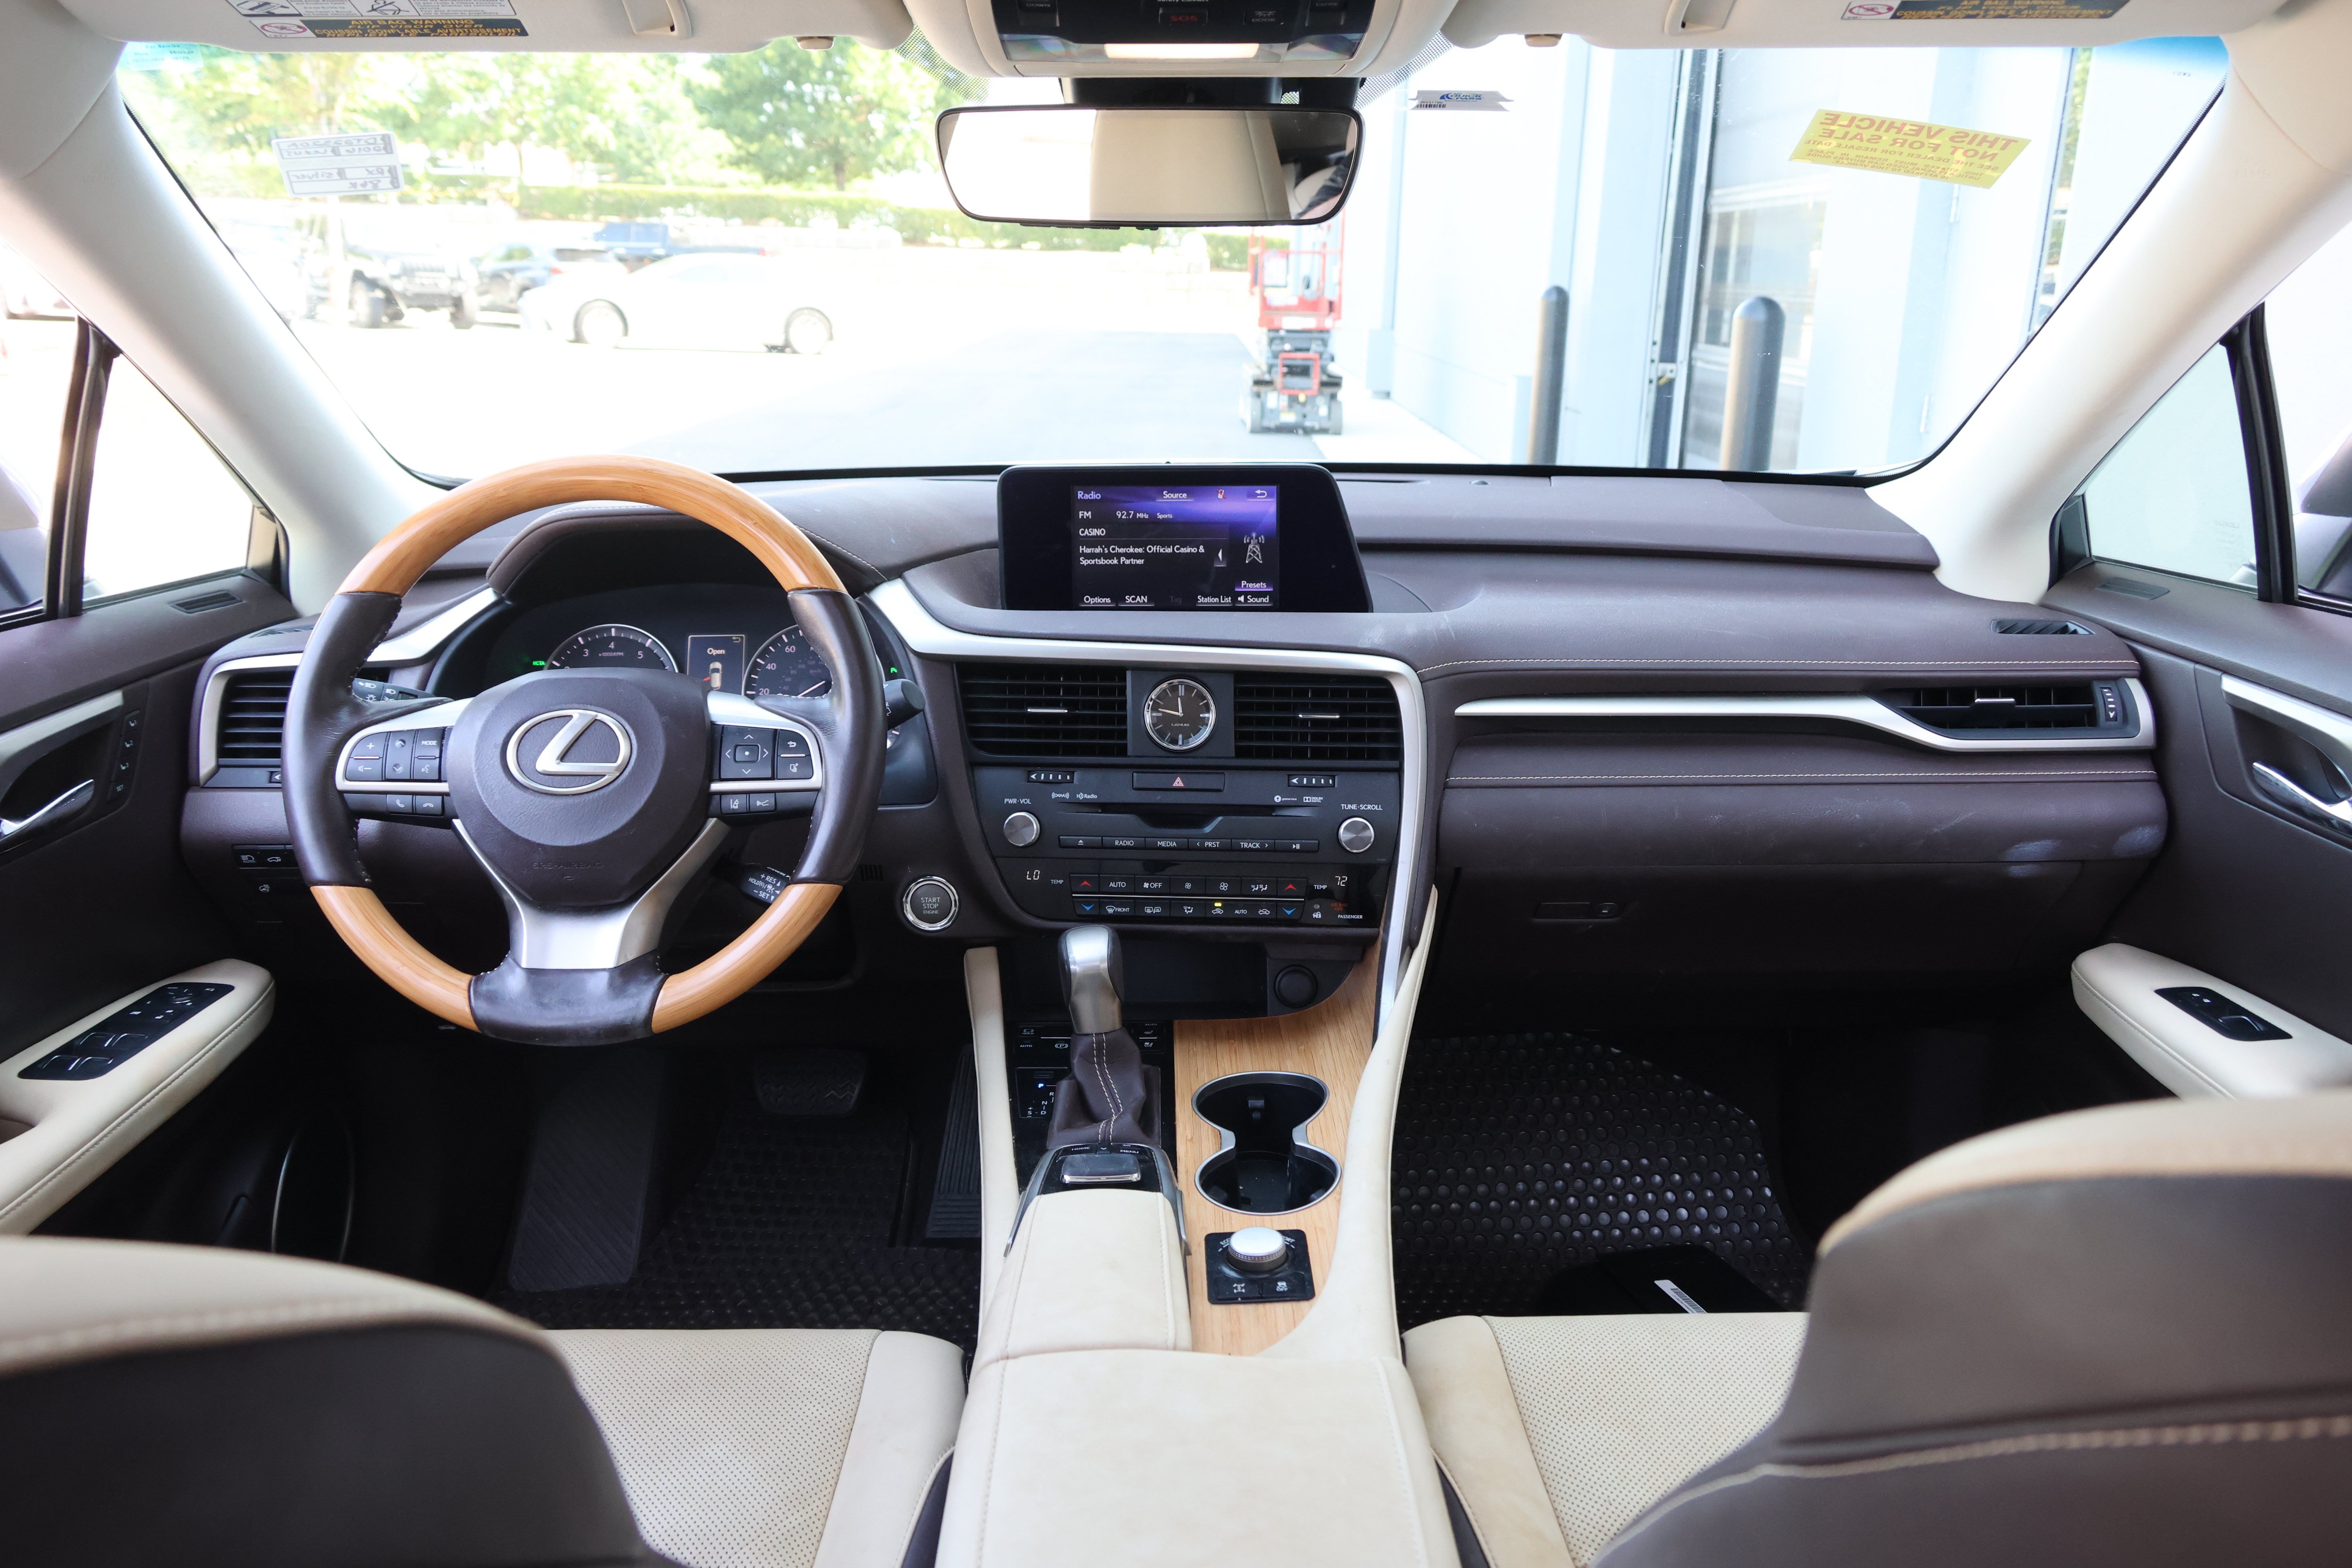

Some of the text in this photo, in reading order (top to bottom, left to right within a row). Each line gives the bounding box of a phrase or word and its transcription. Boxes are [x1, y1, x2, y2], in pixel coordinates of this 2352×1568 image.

[1078, 490, 1101, 500] Radio
[1116, 511, 1134, 519] 92.7
[1079, 545, 1108, 553] Harrah's
[1109, 545, 1145, 553] Cherokee:
[1146, 545, 1173, 553] Official
[1079, 557, 1145, 566] Sportsbook Partner
[1084, 595, 1111, 604] Options
[637, 650, 644, 659] 5
[748, 877, 760, 885] HOLD
[765, 875, 777, 884] RES
[1334, 876, 1348, 886] 72
[759, 891, 770, 899] SET
